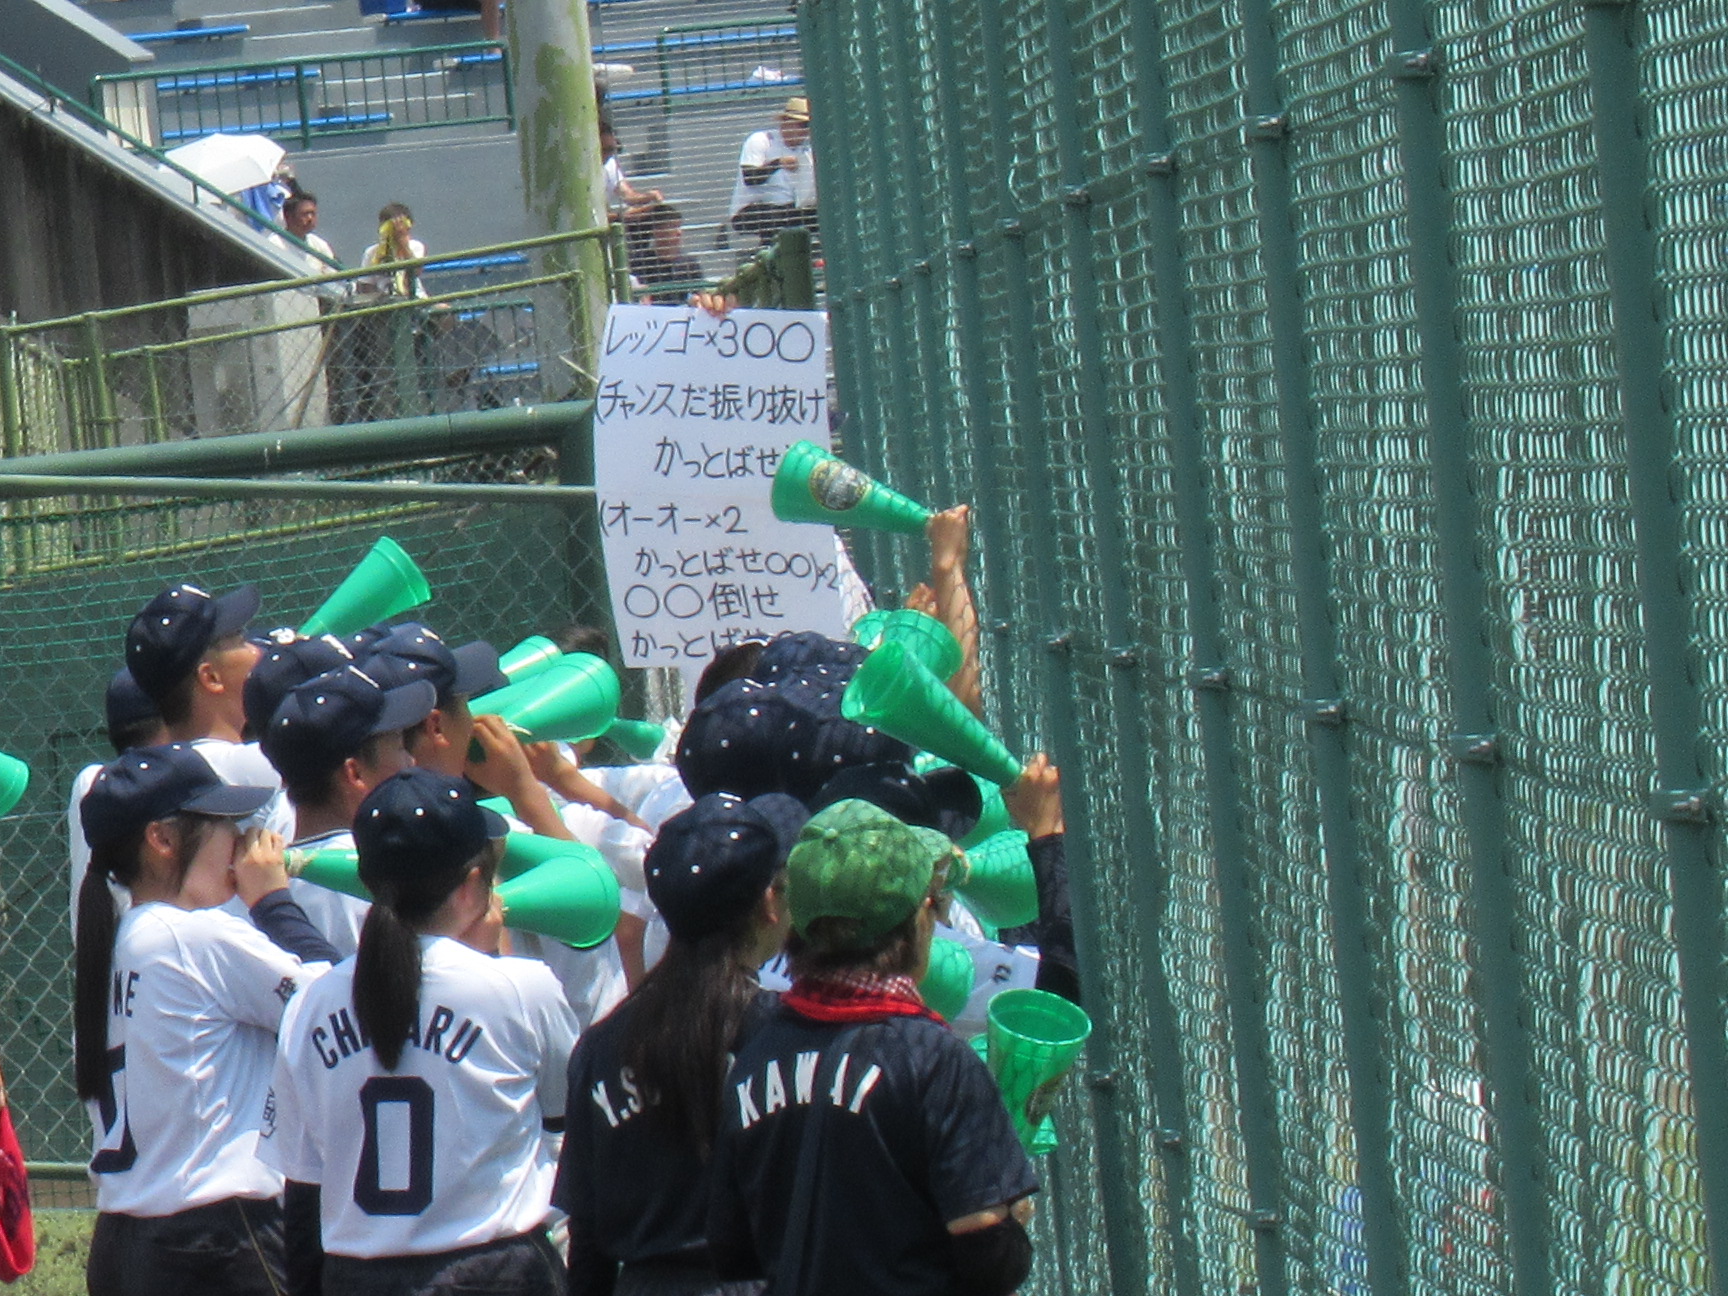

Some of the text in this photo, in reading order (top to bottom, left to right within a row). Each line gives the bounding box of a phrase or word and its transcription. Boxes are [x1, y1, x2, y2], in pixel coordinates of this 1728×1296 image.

[654, 436, 790, 478] かっとばせ
[352, 1075, 436, 1216] 0
